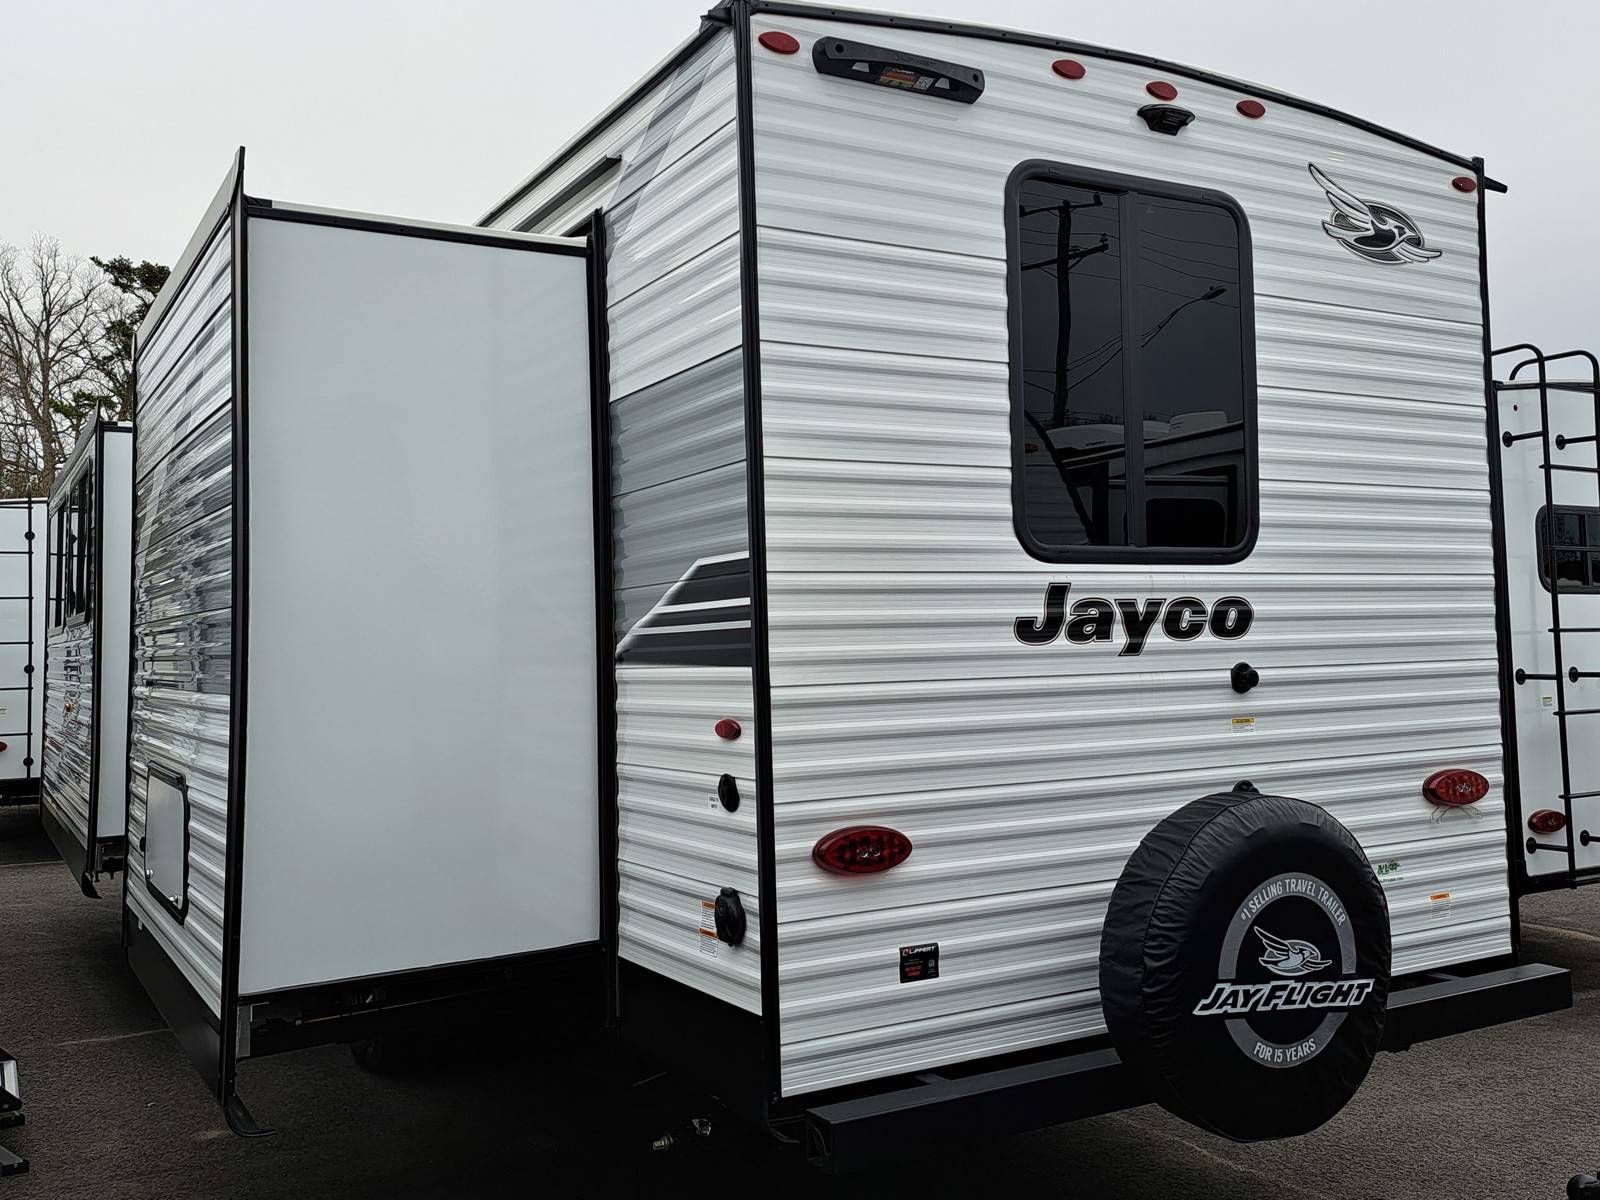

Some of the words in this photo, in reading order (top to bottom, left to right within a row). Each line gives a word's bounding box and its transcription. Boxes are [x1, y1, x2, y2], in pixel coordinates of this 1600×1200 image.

[1014, 582, 1254, 656] Jayco
[1240, 908, 1252, 920] #1
[1248, 881, 1283, 913] SELLING
[1285, 879, 1316, 897] TRAVEL
[1317, 886, 1346, 926] TRAILER
[1253, 1042, 1271, 1062] FOR
[1274, 1049, 1283, 1062] 15
[1286, 1038, 1316, 1062] YEARS
